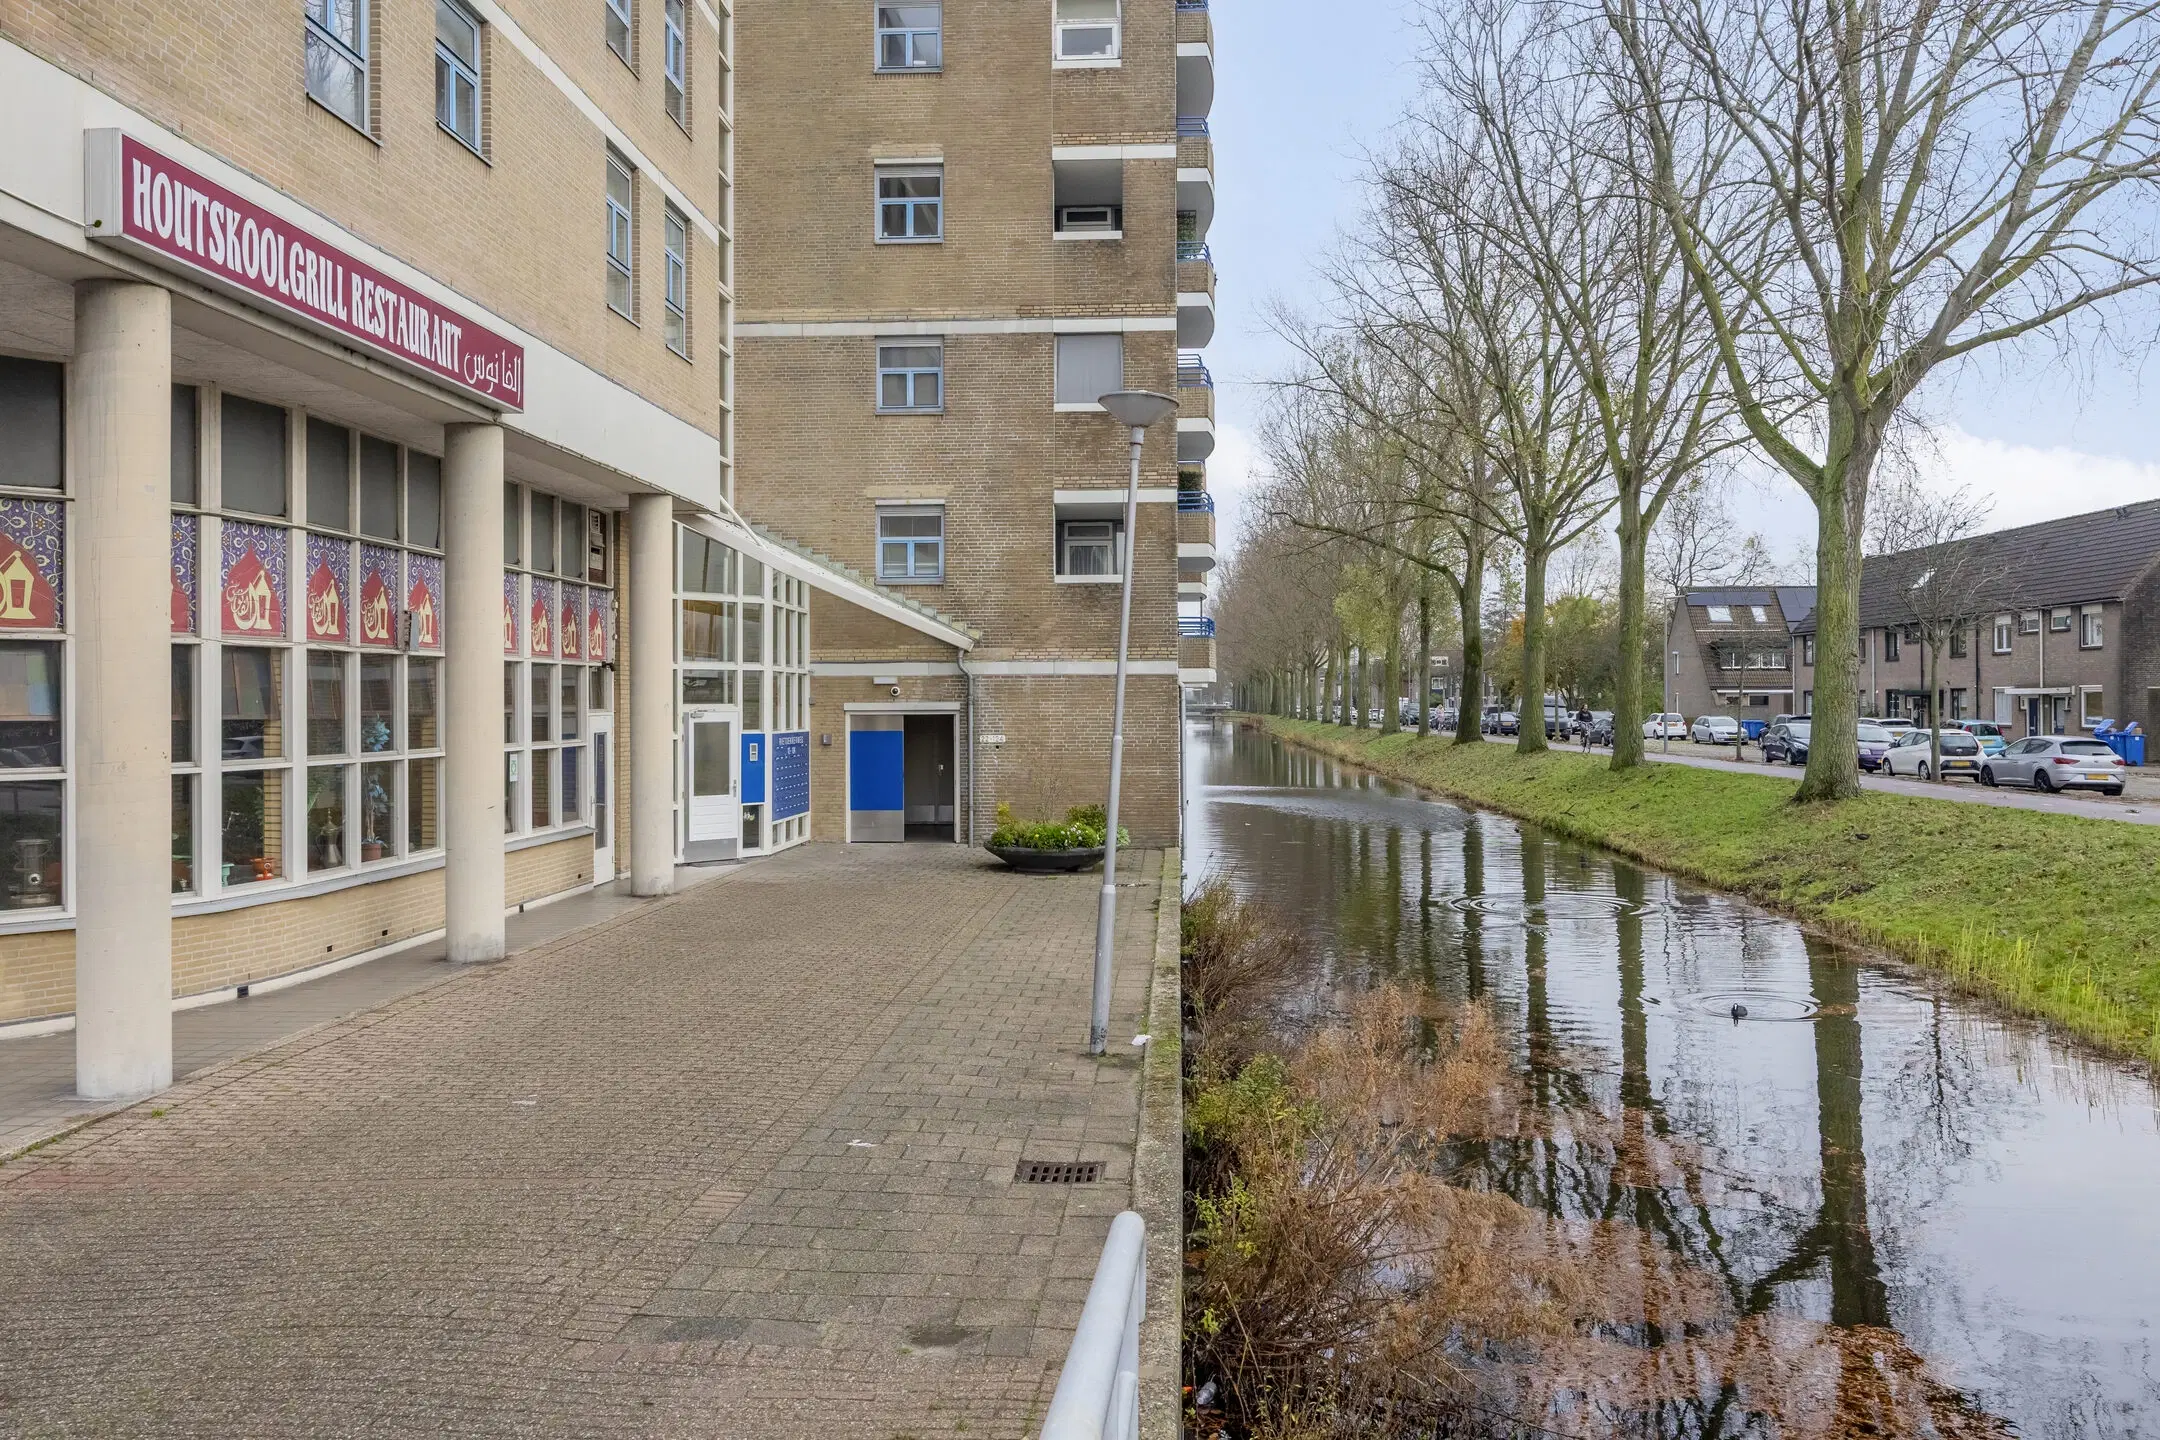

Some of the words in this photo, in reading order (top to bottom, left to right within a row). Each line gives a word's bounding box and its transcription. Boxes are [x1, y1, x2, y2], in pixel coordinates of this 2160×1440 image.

[132, 157, 348, 323] HOUTSKOOLGRILL
[351, 272, 462, 373] RESTAURANT
[463, 349, 521, 403] الفانوس
